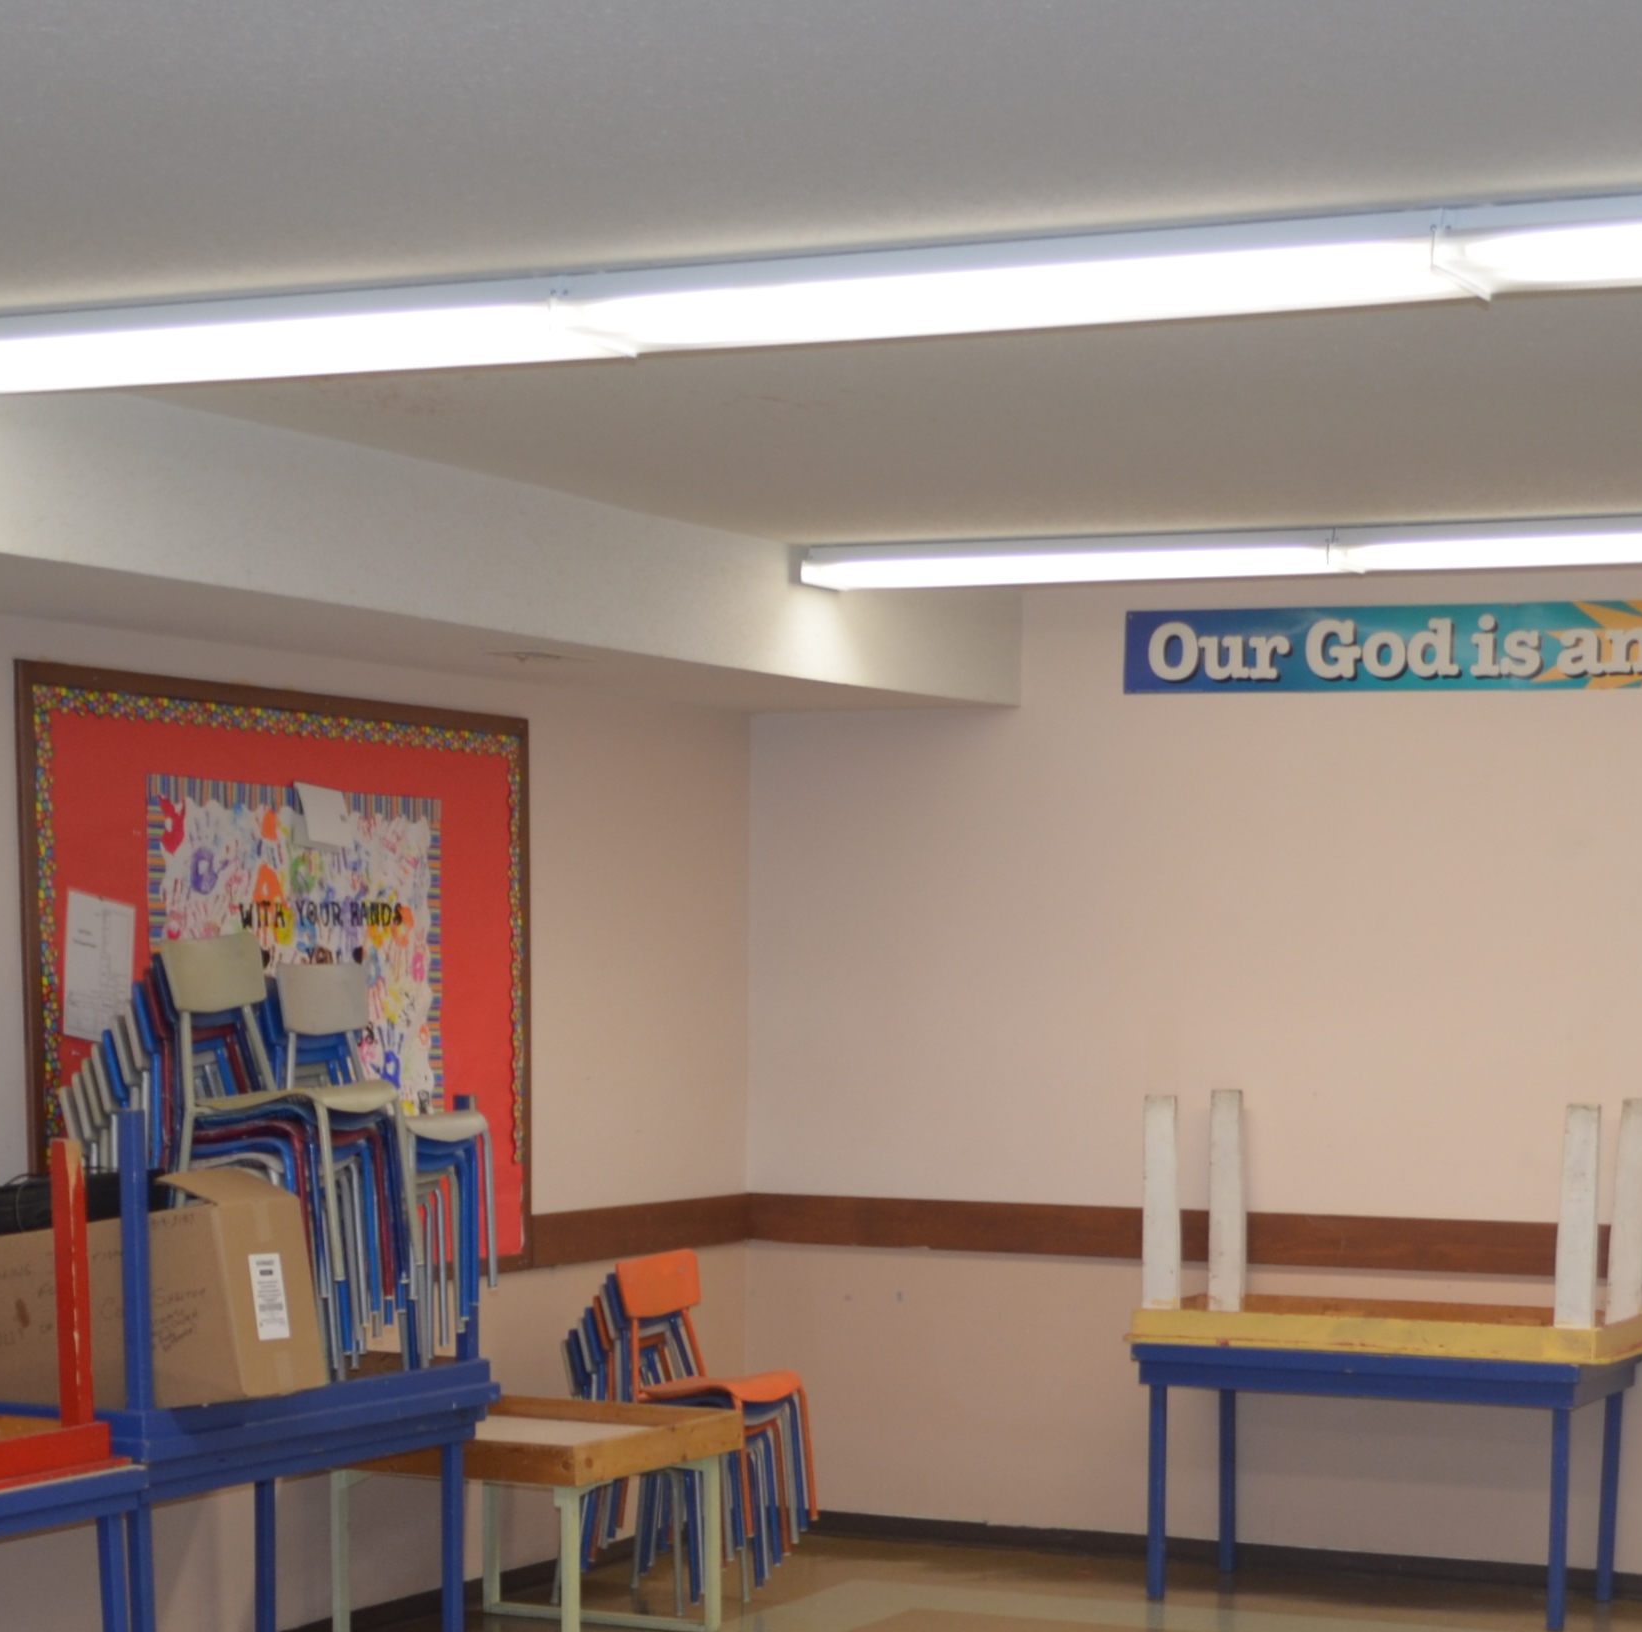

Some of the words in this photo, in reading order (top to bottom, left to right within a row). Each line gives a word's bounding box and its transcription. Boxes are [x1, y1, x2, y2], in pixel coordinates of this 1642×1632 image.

[1147, 621, 1291, 681] Our
[1304, 617, 1460, 680] God
[1470, 615, 1542, 677] is
[239, 900, 286, 929] WITH
[296, 900, 344, 927] YOUR
[350, 901, 403, 927] HANDS
